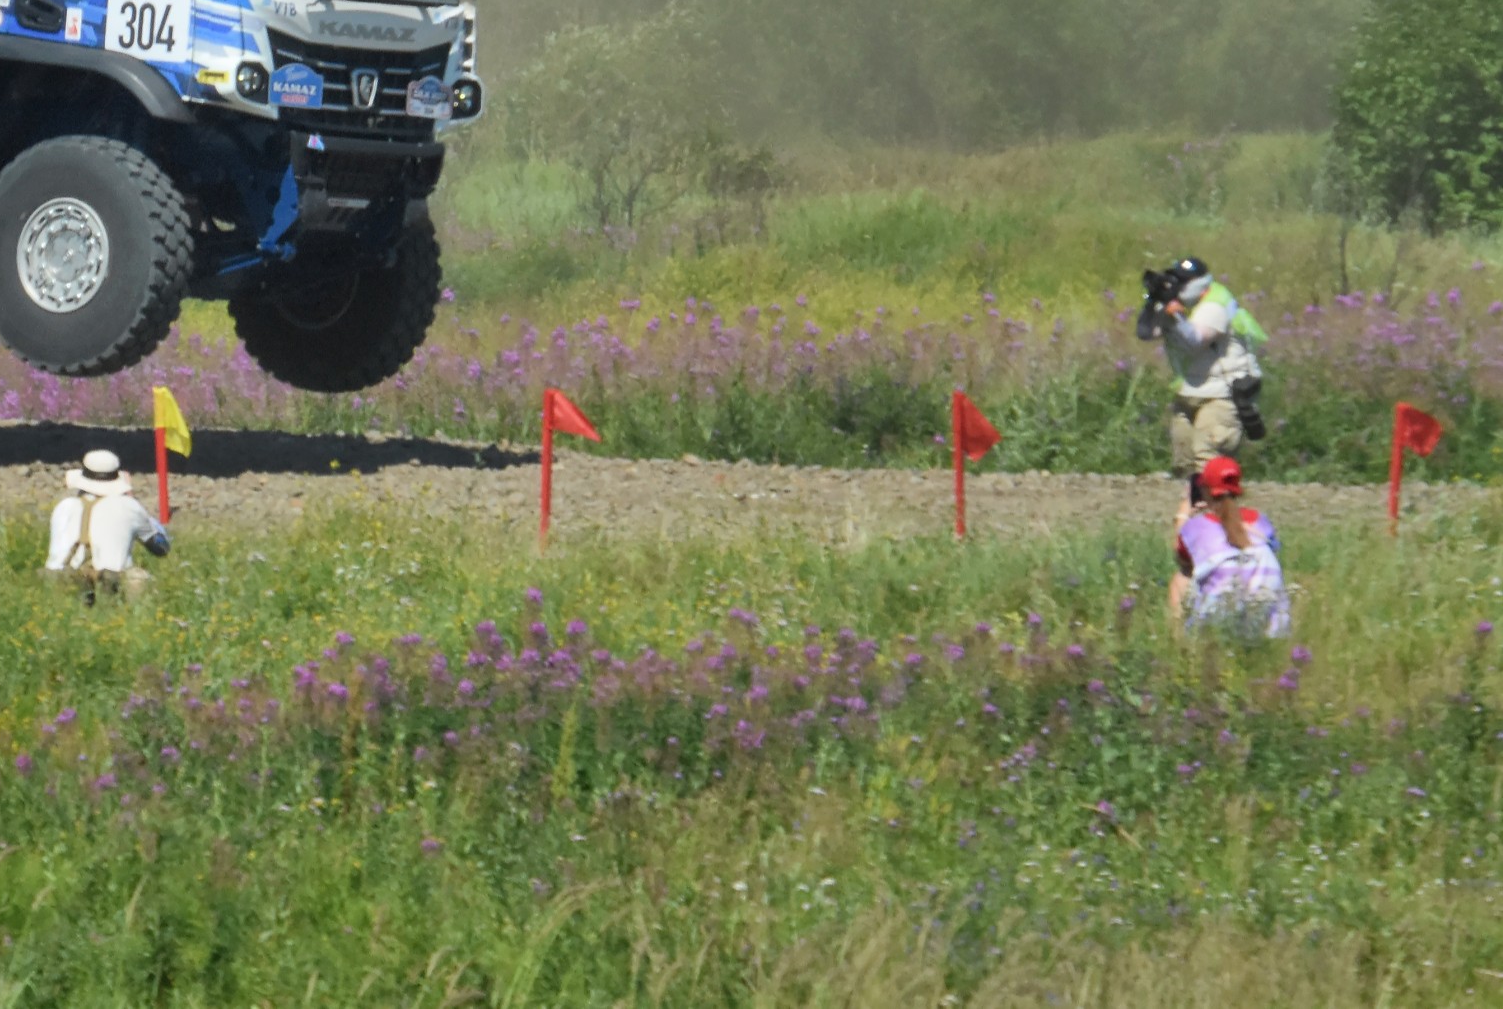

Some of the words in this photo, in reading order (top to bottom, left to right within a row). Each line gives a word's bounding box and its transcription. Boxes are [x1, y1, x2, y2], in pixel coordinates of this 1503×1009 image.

[118, 1, 175, 52] 304
[318, 20, 417, 41] KAMAZ
[273, 81, 316, 96] KAMAZ
